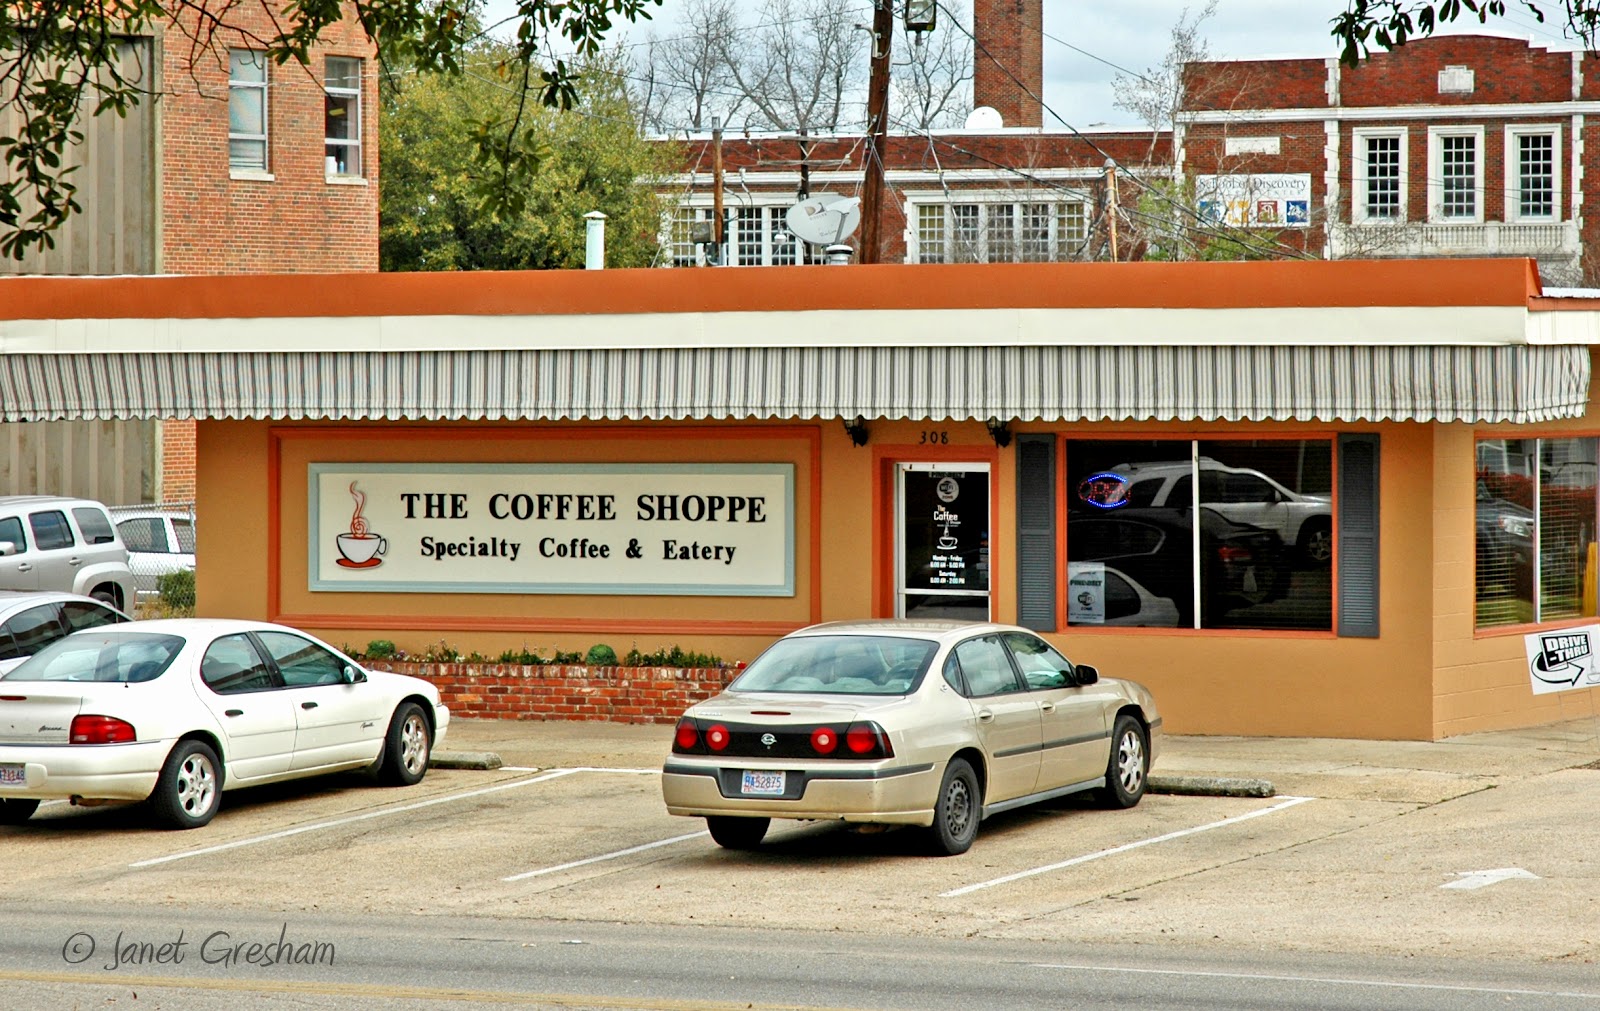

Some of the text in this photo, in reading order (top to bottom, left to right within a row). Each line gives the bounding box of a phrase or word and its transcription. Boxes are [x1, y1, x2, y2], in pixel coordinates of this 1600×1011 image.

[1253, 177, 1308, 191] Discovery
[919, 431, 949, 444] 308
[1078, 480, 1132, 502] OPEN
[400, 493, 767, 523] THE COFFEE SHOPPE
[933, 510, 959, 521] Coffee
[420, 536, 737, 565] Specialty Coffee & Eatery
[1544, 635, 1587, 652] DRIVE
